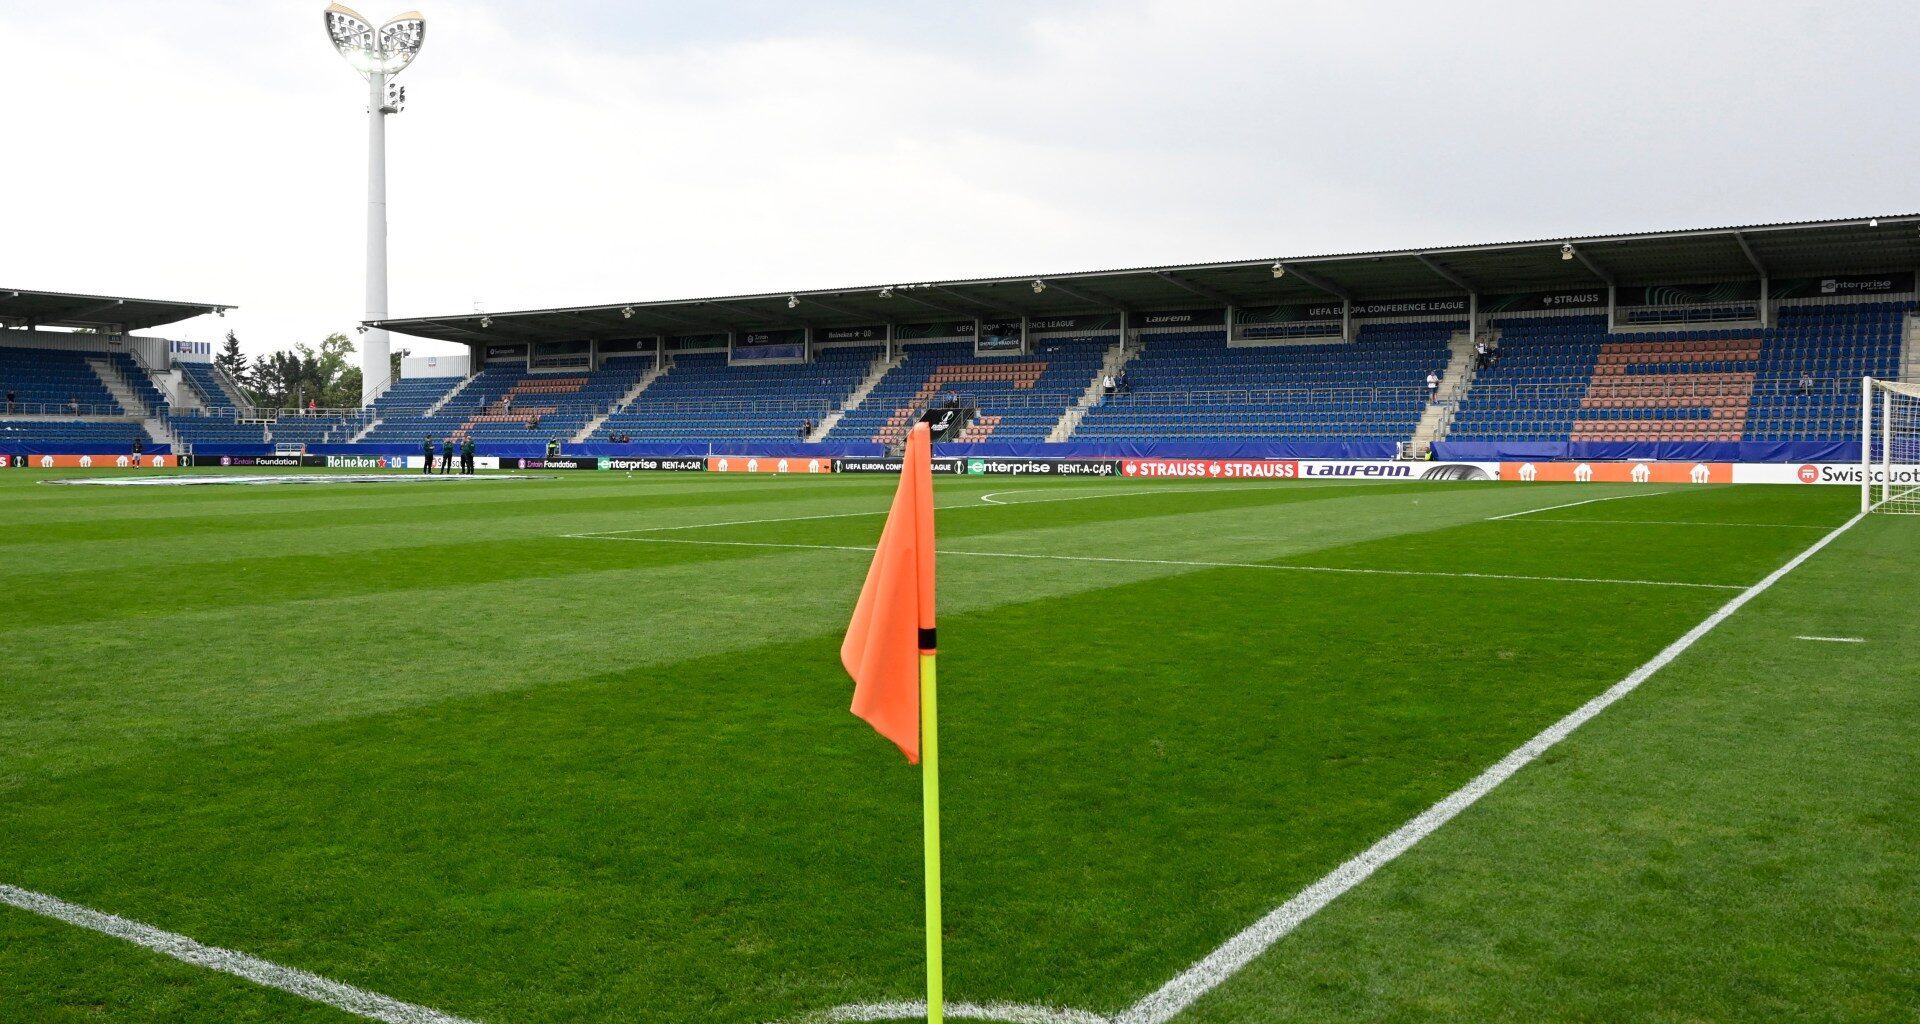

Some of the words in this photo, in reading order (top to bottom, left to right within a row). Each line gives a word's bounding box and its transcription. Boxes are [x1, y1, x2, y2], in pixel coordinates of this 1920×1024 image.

[1554, 294, 1599, 305] STRAUSS
[1309, 308, 1331, 316] UEFA
[1333, 306, 1366, 315] EUOPA
[1367, 303, 1427, 313] CONFERENCE
[1428, 301, 1465, 311] LEAGUE
[256, 458, 298, 466] Foundation
[327, 455, 376, 469] Heineken
[544, 460, 577, 468] Foundation
[600, 459, 657, 471] enterprise
[662, 461, 701, 470] RENT-A-CAR
[845, 463, 861, 471] UEFA
[862, 463, 886, 471] EUROPA
[930, 463, 951, 471] EAGUE
[973, 461, 1051, 476] enterprise
[1057, 464, 1113, 474] RENT-A-CAR
[1140, 463, 1206, 476] STRAUSS
[1224, 463, 1294, 477] STRAUSS
